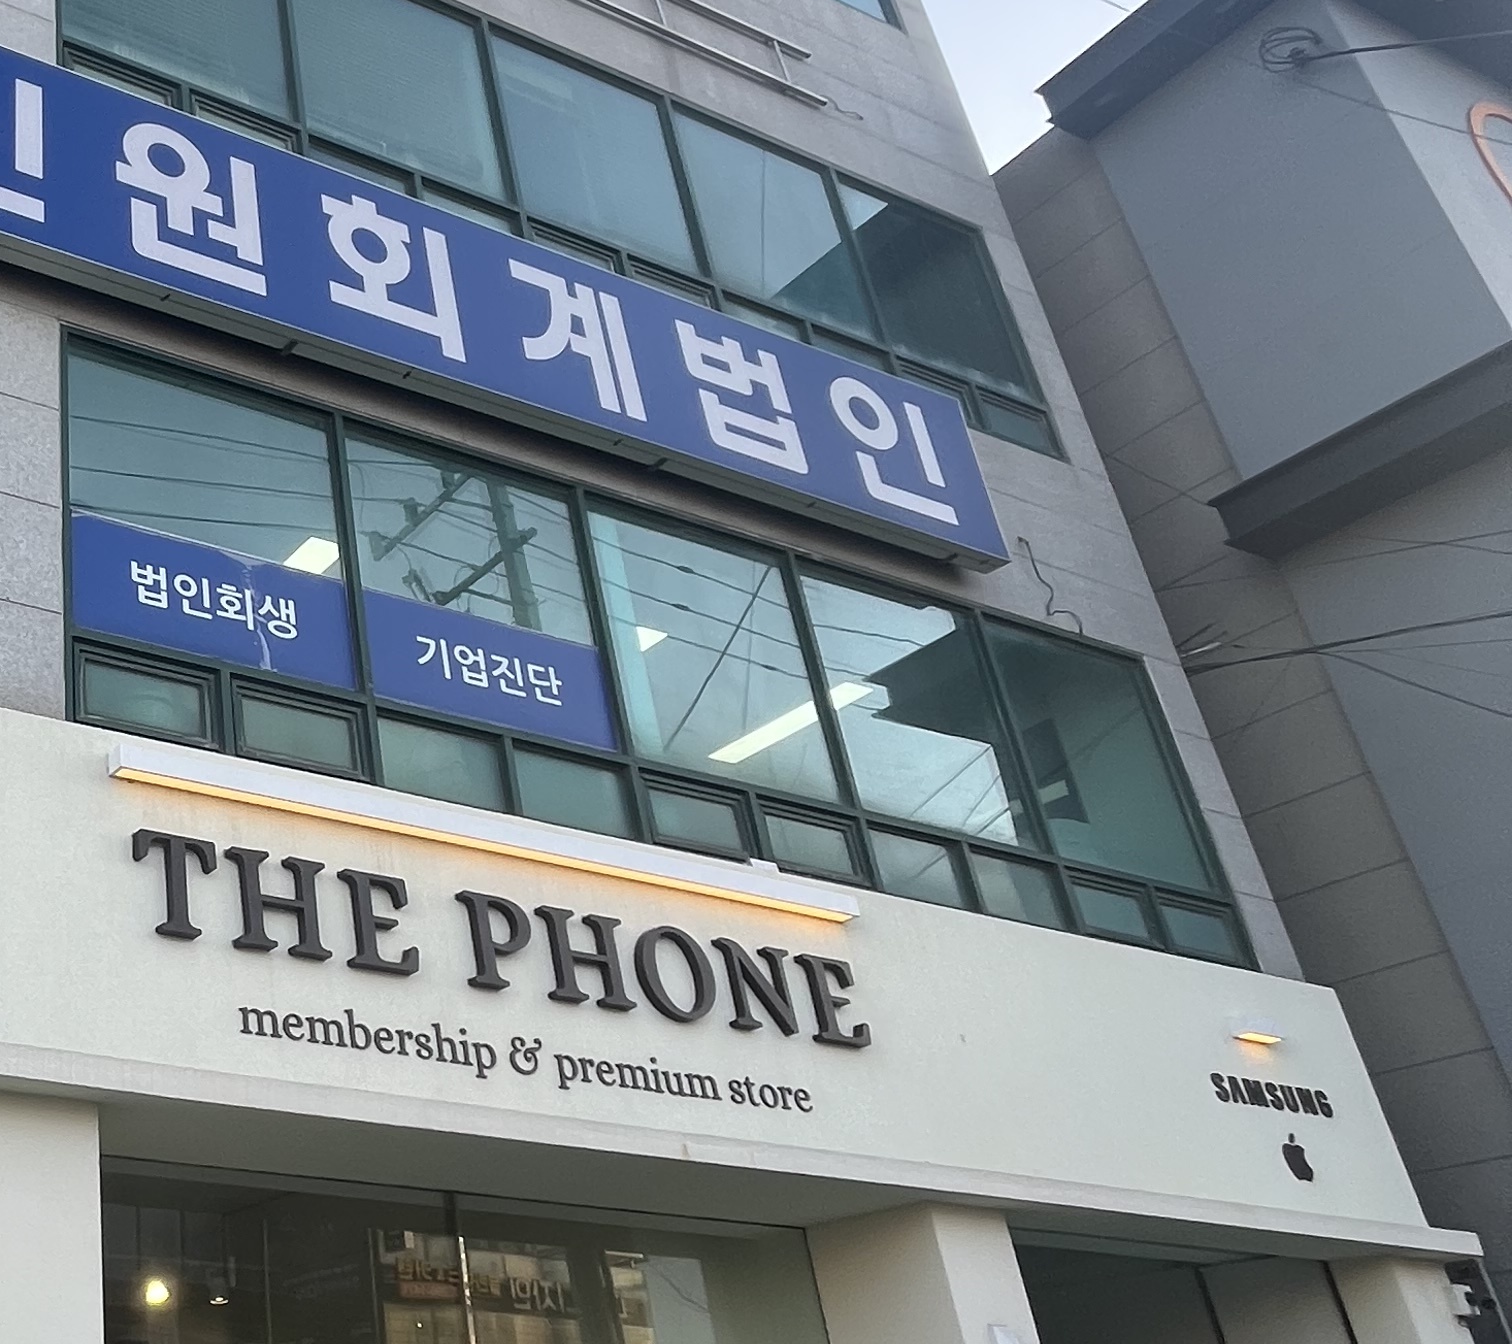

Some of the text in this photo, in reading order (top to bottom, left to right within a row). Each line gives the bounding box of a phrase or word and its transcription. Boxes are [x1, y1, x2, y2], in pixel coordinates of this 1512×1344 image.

[130, 560, 298, 639] 법인회생
[416, 635, 563, 706] 기업진단
[132, 829, 872, 1049] THE PHONE
[239, 1004, 814, 1113] membership & premium store
[1209, 1072, 1334, 1119] SAMSUNG
